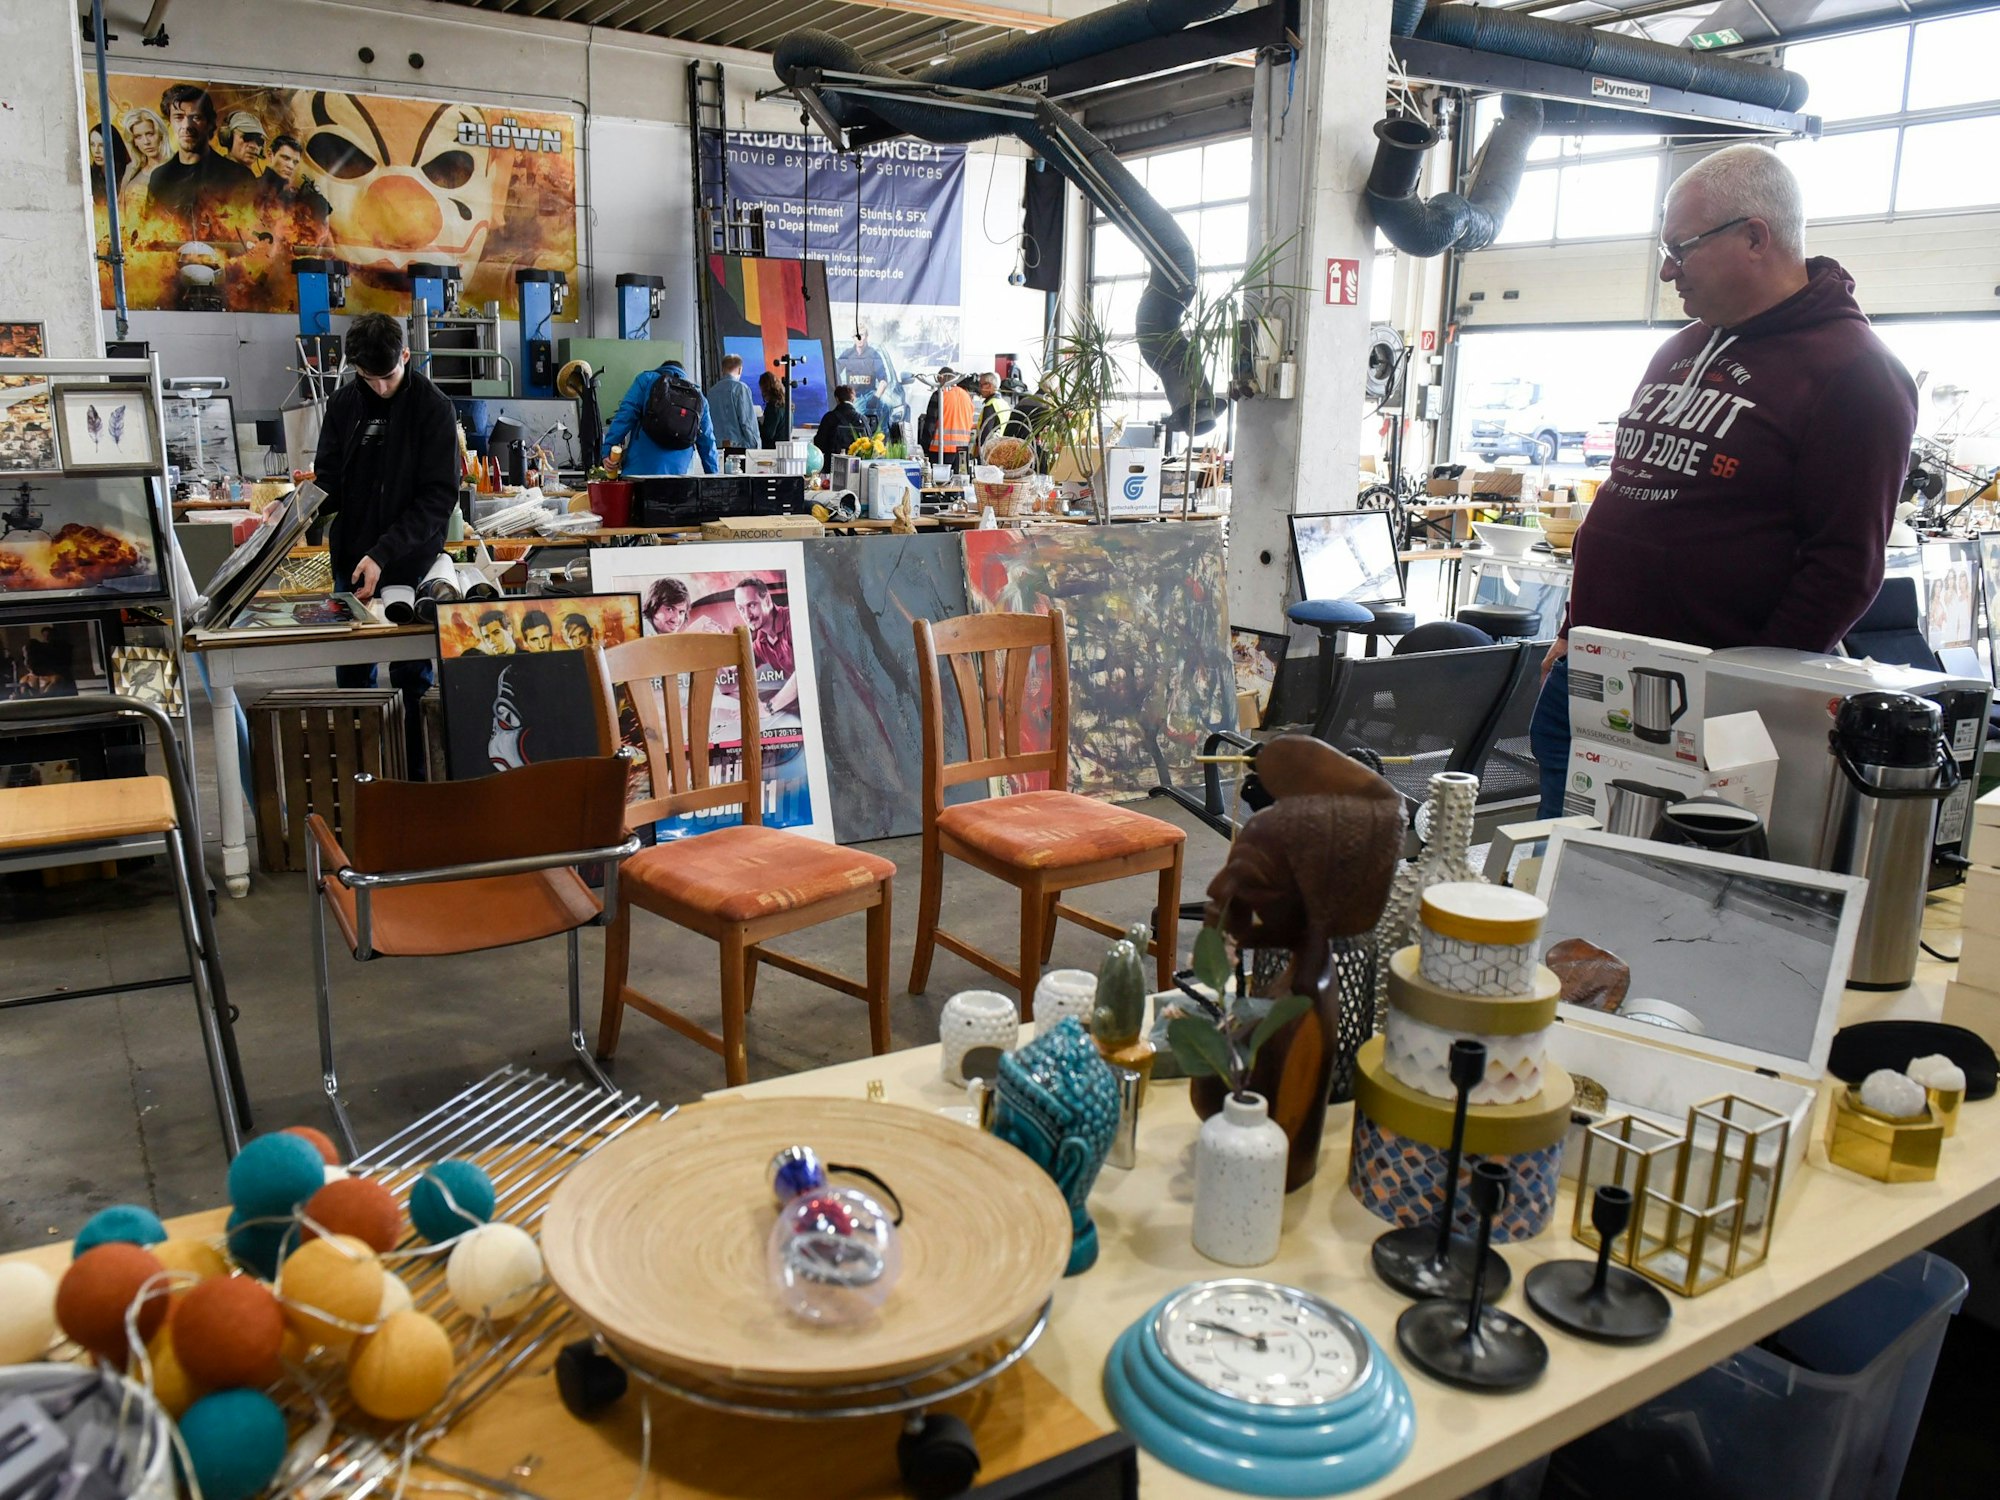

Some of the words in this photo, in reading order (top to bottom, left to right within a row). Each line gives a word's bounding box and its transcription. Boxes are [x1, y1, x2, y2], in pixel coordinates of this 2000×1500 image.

[1594, 79, 1649, 99] Plymex!
[503, 117, 517, 127] DER
[458, 122, 562, 153] CLOWN
[726, 149, 775, 165] movie
[784, 153, 848, 173] experts
[876, 161, 943, 180] services
[783, 202, 843, 218] Department
[860, 208, 893, 221] Stunts
[895, 210, 903, 221] &
[906, 211, 927, 223] SFX
[860, 224, 933, 240] Postproduction
[831, 252, 851, 263] Infos
[1727, 362, 1752, 386] TWO
[1641, 432, 1708, 477] EDGE
[1710, 453, 1740, 479] 56
[1618, 485, 1679, 501] SPEEDWAY
[733, 529, 783, 539] ARCOROC
[1576, 727, 1631, 746] WASSERKOCHER
